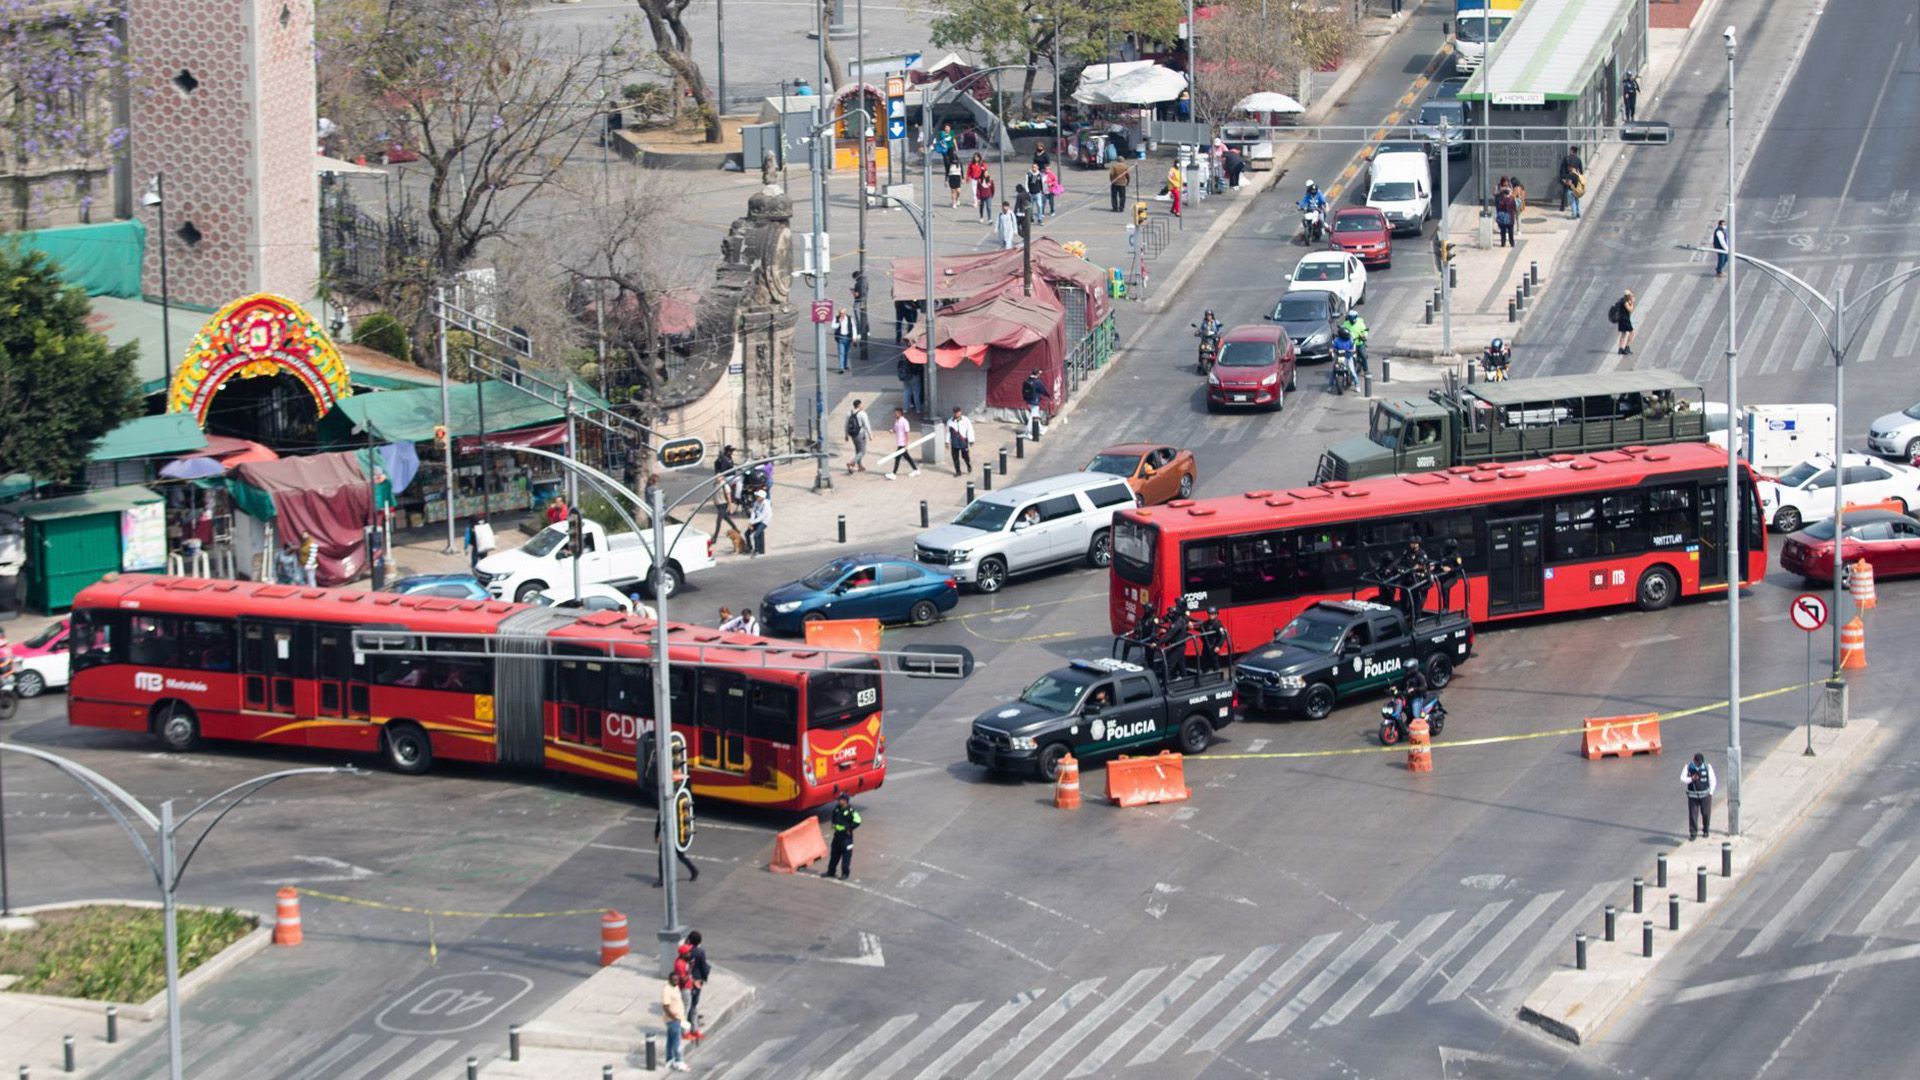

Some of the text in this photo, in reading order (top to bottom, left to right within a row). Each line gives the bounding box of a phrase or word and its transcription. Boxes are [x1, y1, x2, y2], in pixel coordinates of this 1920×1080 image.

[1364, 657, 1401, 679] POLICIA
[858, 690, 875, 705] 458
[606, 713, 654, 739] CDM
[1107, 719, 1156, 741] POLICIA
[833, 746, 857, 761] CDMX
